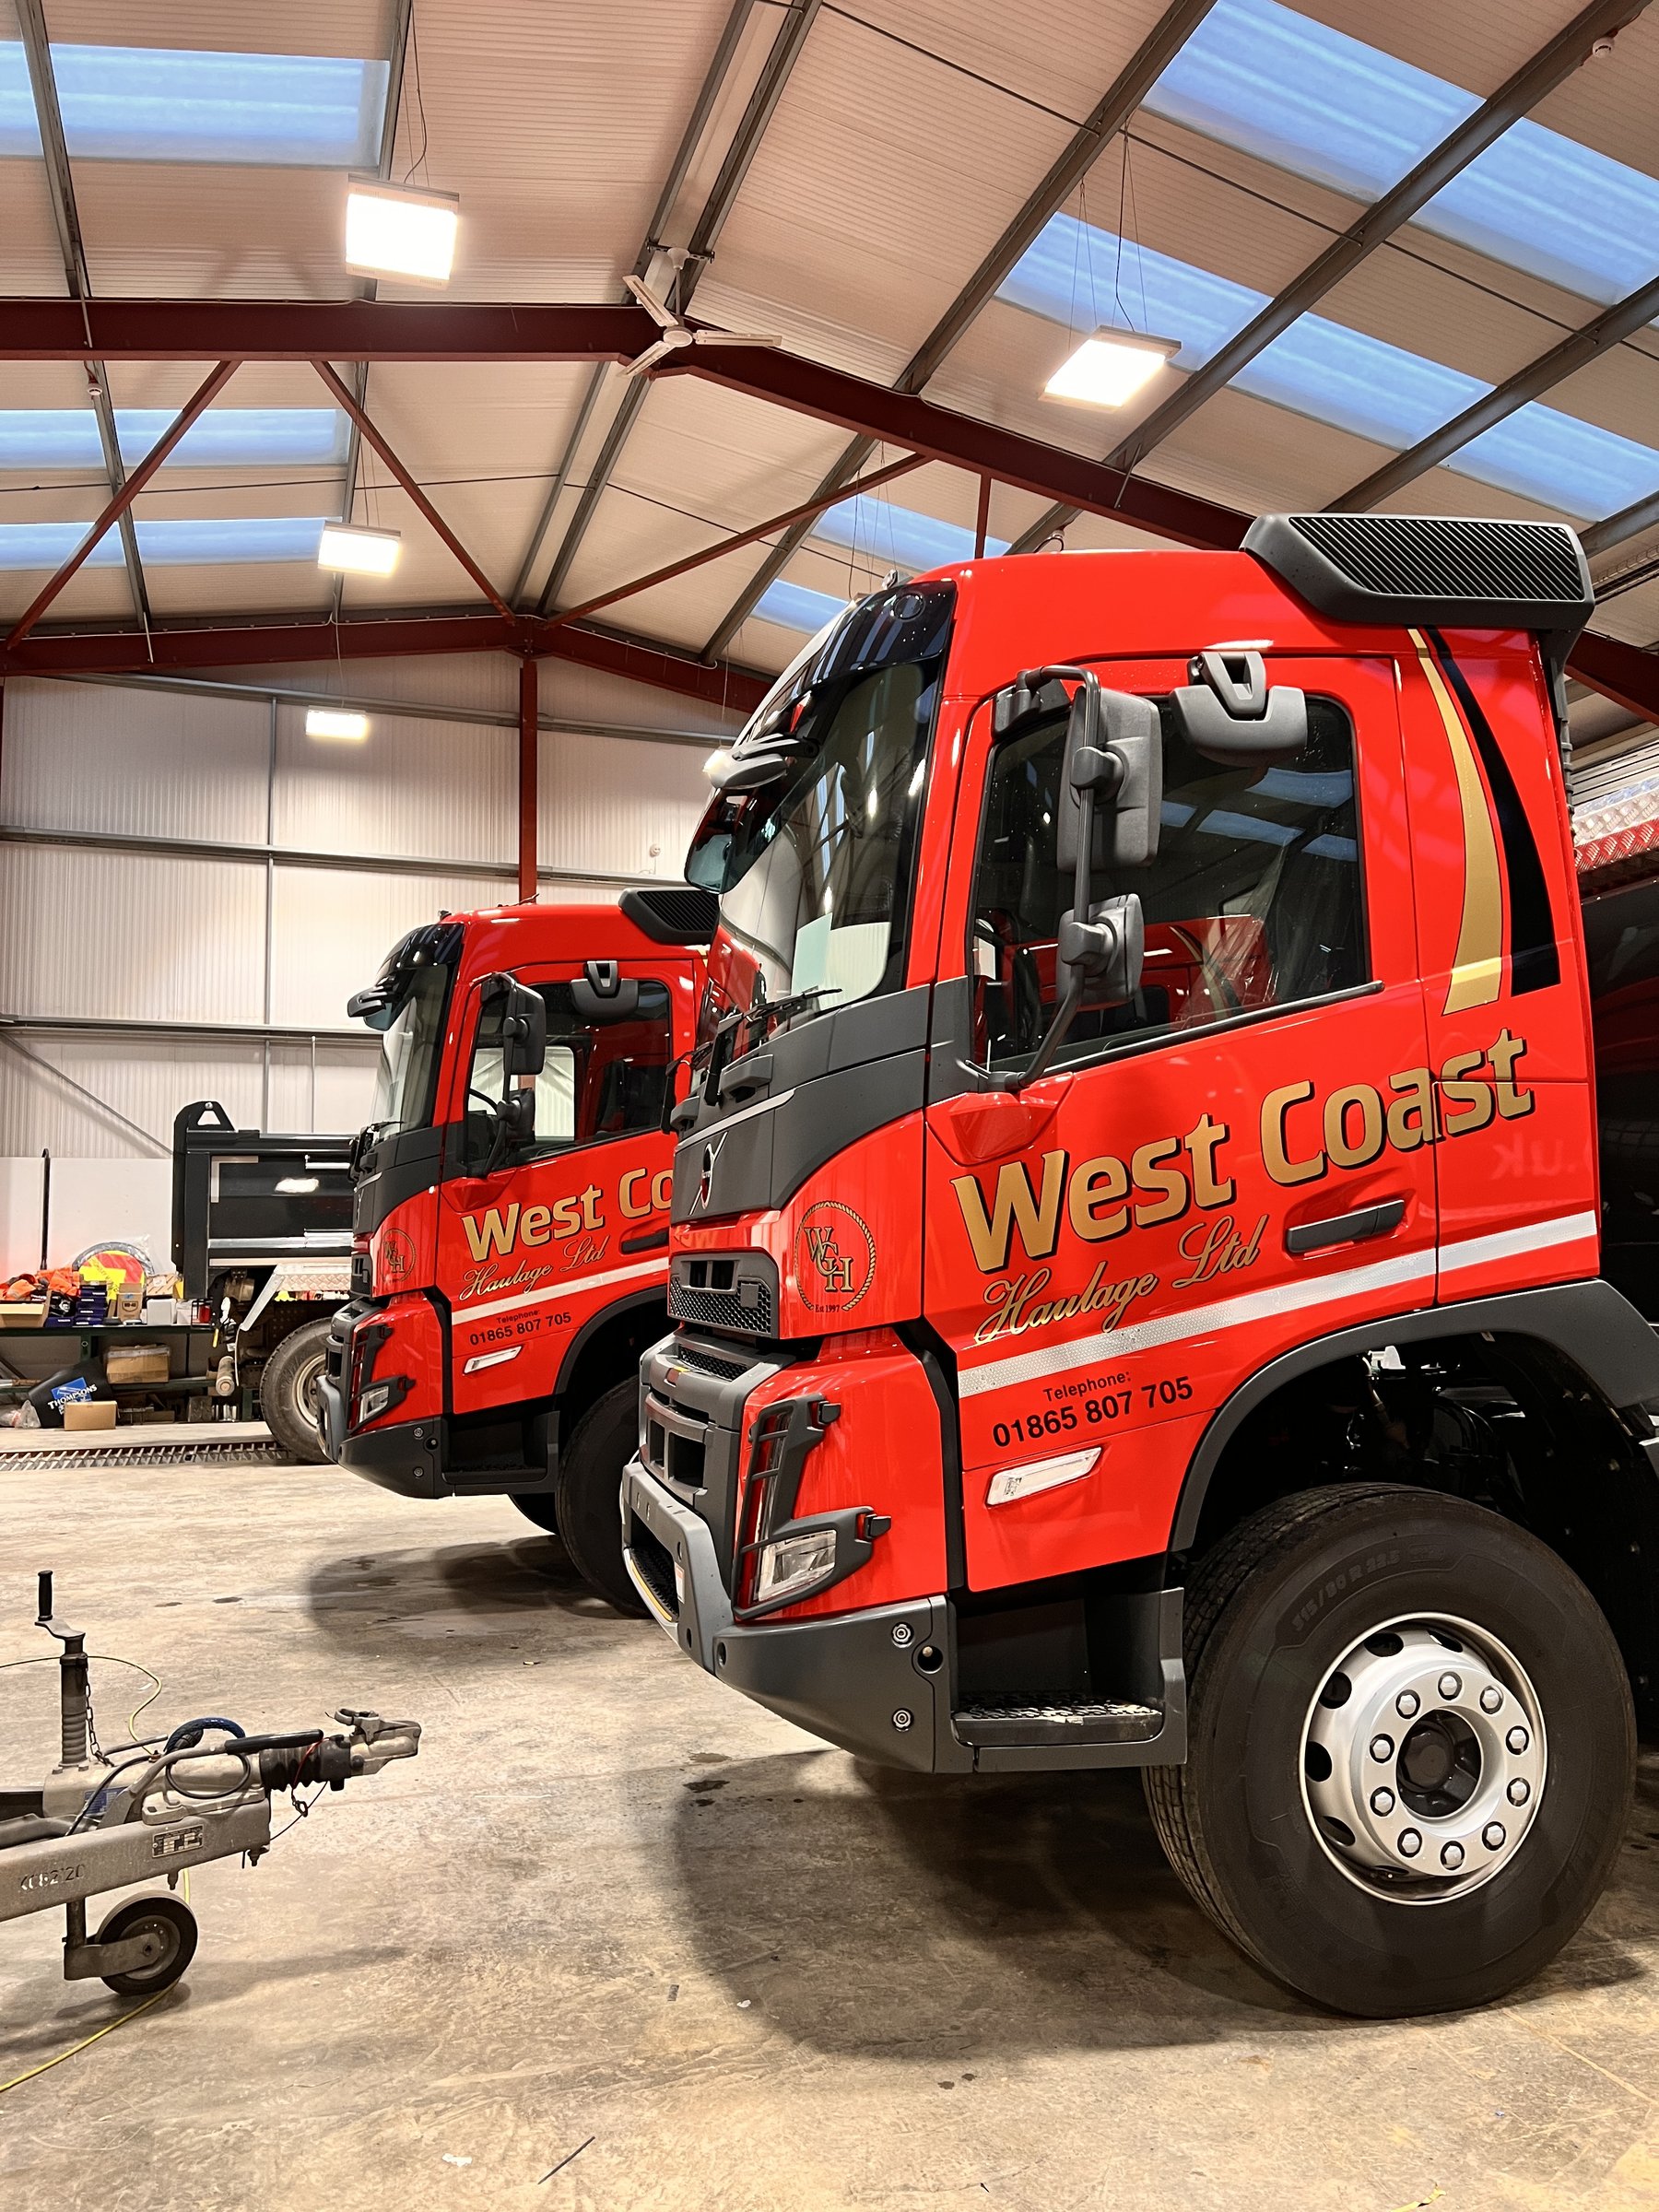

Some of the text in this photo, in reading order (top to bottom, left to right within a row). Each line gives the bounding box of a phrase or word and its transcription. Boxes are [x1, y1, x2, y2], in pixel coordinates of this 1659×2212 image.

[949, 1028, 1540, 1275] West Coast
[461, 1184, 606, 1263] West
[459, 1235, 610, 1301] Haulage Ltd
[974, 1214, 1269, 1344] Haulage Ltd
[470, 1312, 571, 1346] 01865 807 705
[47, 1383, 98, 1410] THOMPSONS
[993, 1375, 1194, 1447] 01865 807 705
[1043, 1371, 1132, 1403] Telephone:
